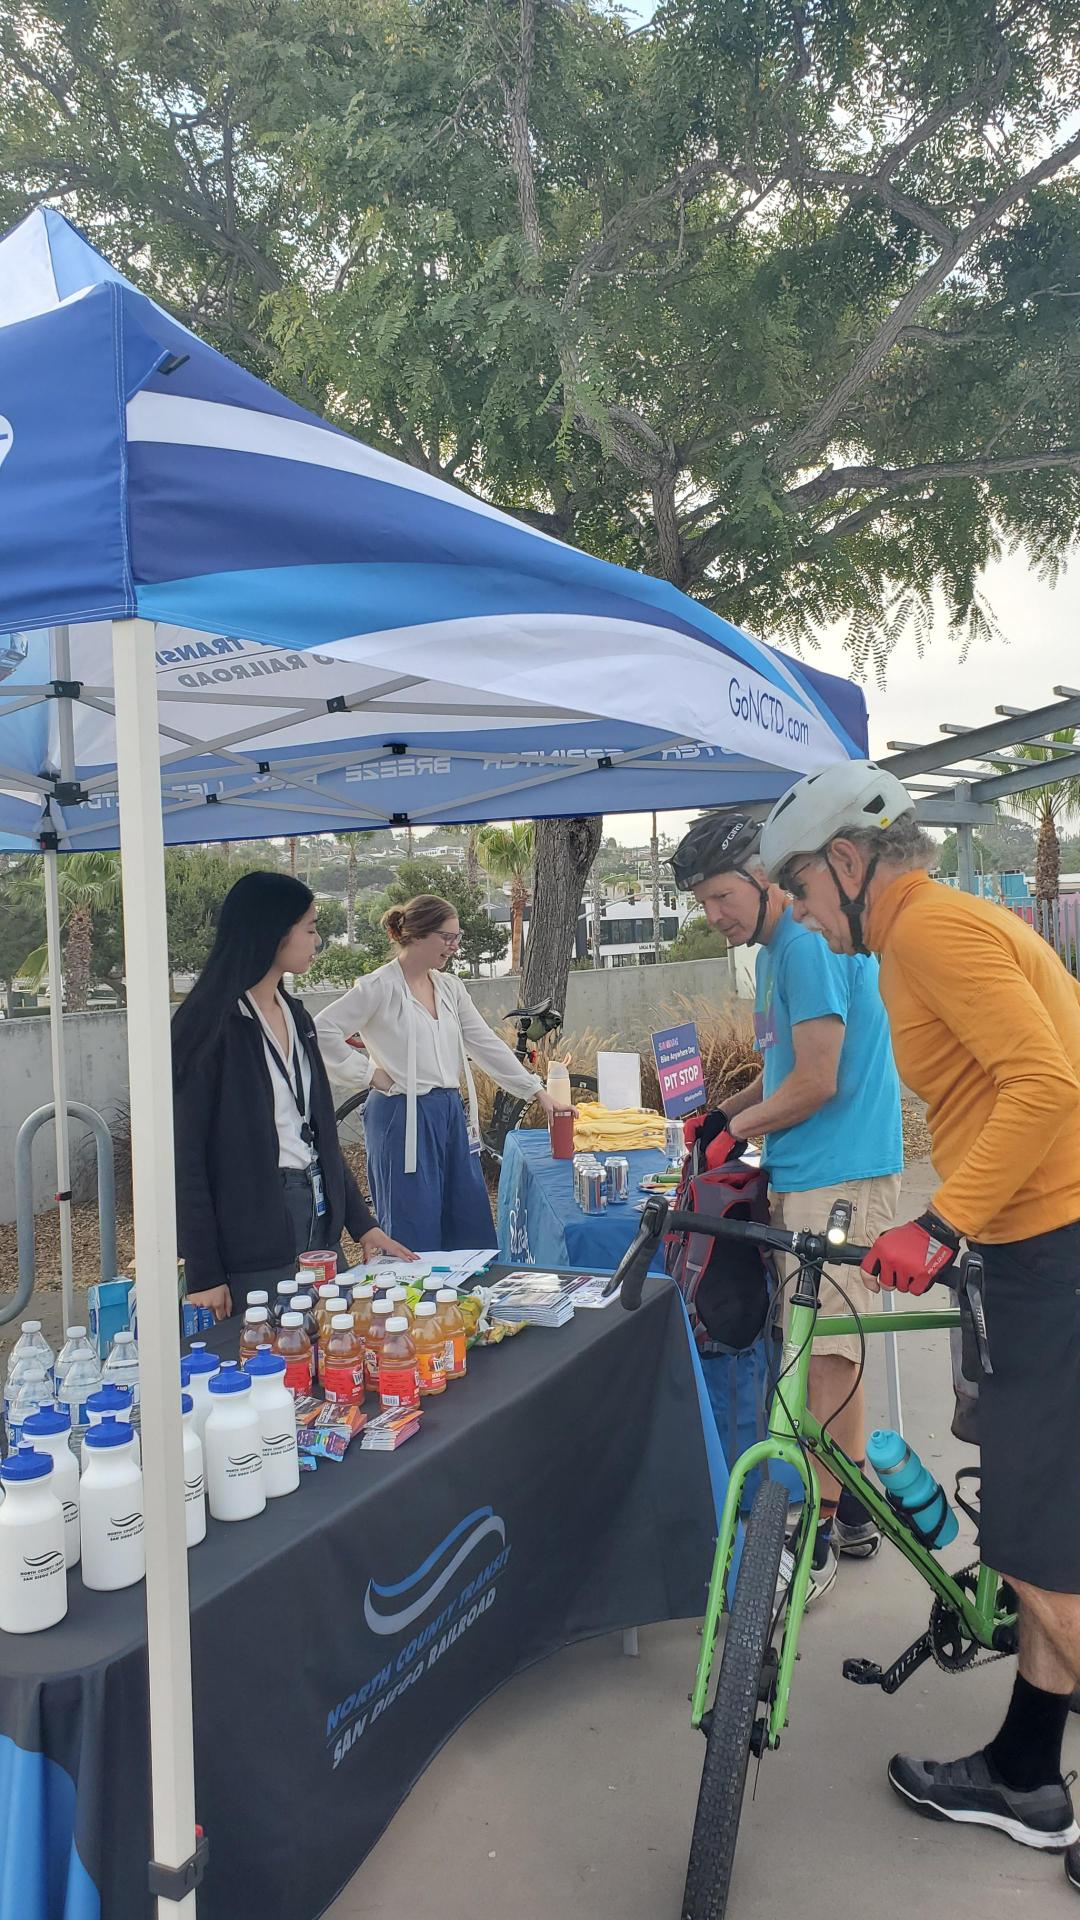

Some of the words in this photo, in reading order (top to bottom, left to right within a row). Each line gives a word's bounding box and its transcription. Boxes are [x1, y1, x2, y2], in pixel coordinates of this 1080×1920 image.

[728, 677, 809, 745] GoNCTD.com
[664, 1072, 678, 1091] PIT
[679, 1065, 699, 1086] STOP
[326, 1661, 392, 1737] NORTH
[396, 1599, 457, 1673] COUNTY
[458, 1544, 512, 1610] TRANSIT
[332, 1713, 368, 1770] SAN
[370, 1660, 425, 1725] DIEGO
[427, 1586, 497, 1669] RAILROAD
